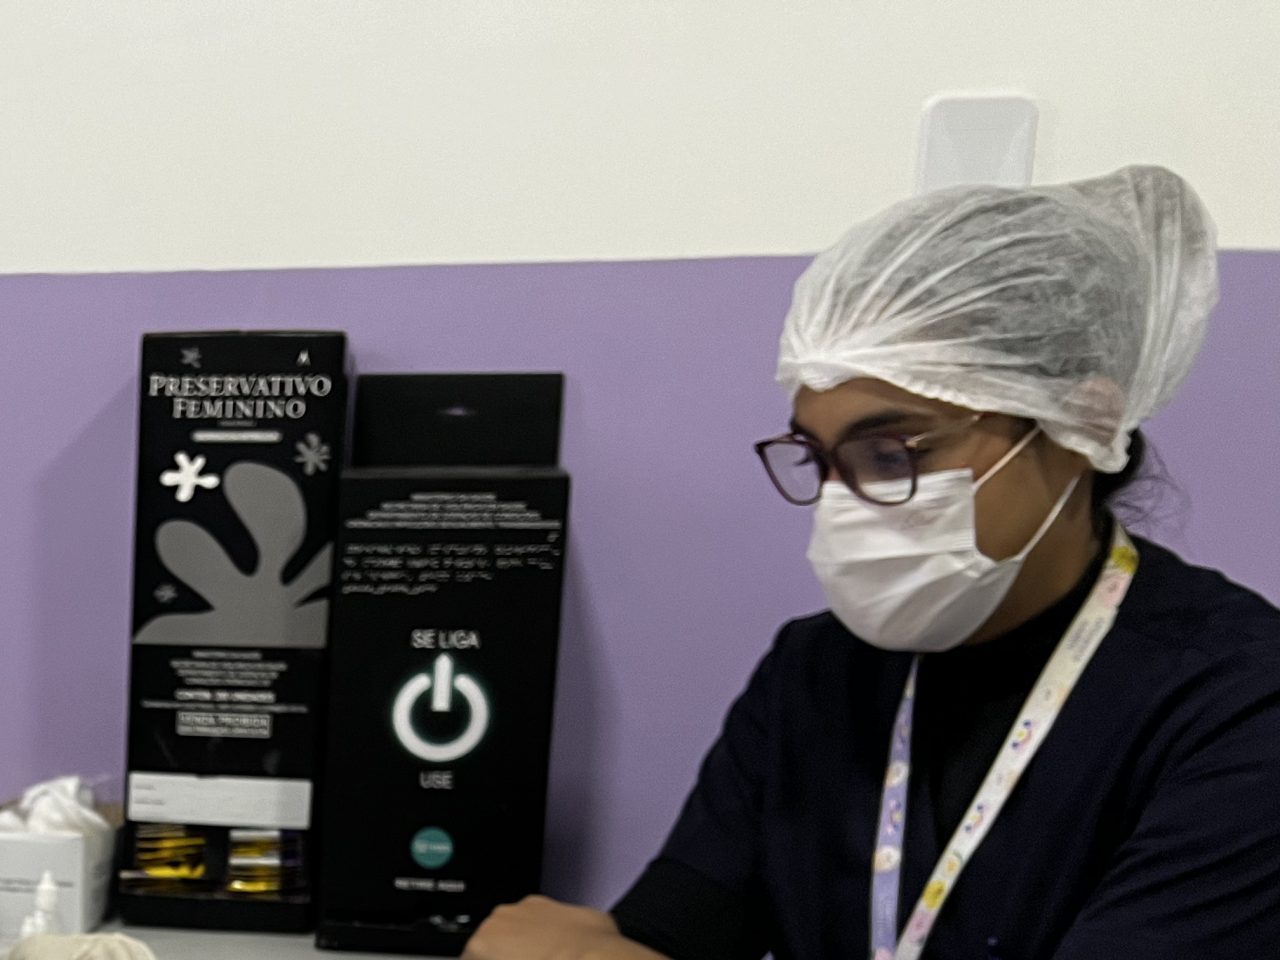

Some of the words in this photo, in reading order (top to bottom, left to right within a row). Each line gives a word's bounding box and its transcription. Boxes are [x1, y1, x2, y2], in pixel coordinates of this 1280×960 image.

[148, 374, 332, 398] PRESERVATIVO
[172, 397, 306, 419] FEMININO
[411, 629, 436, 650] SE
[438, 629, 481, 650] LIGA
[419, 771, 454, 790] USE
